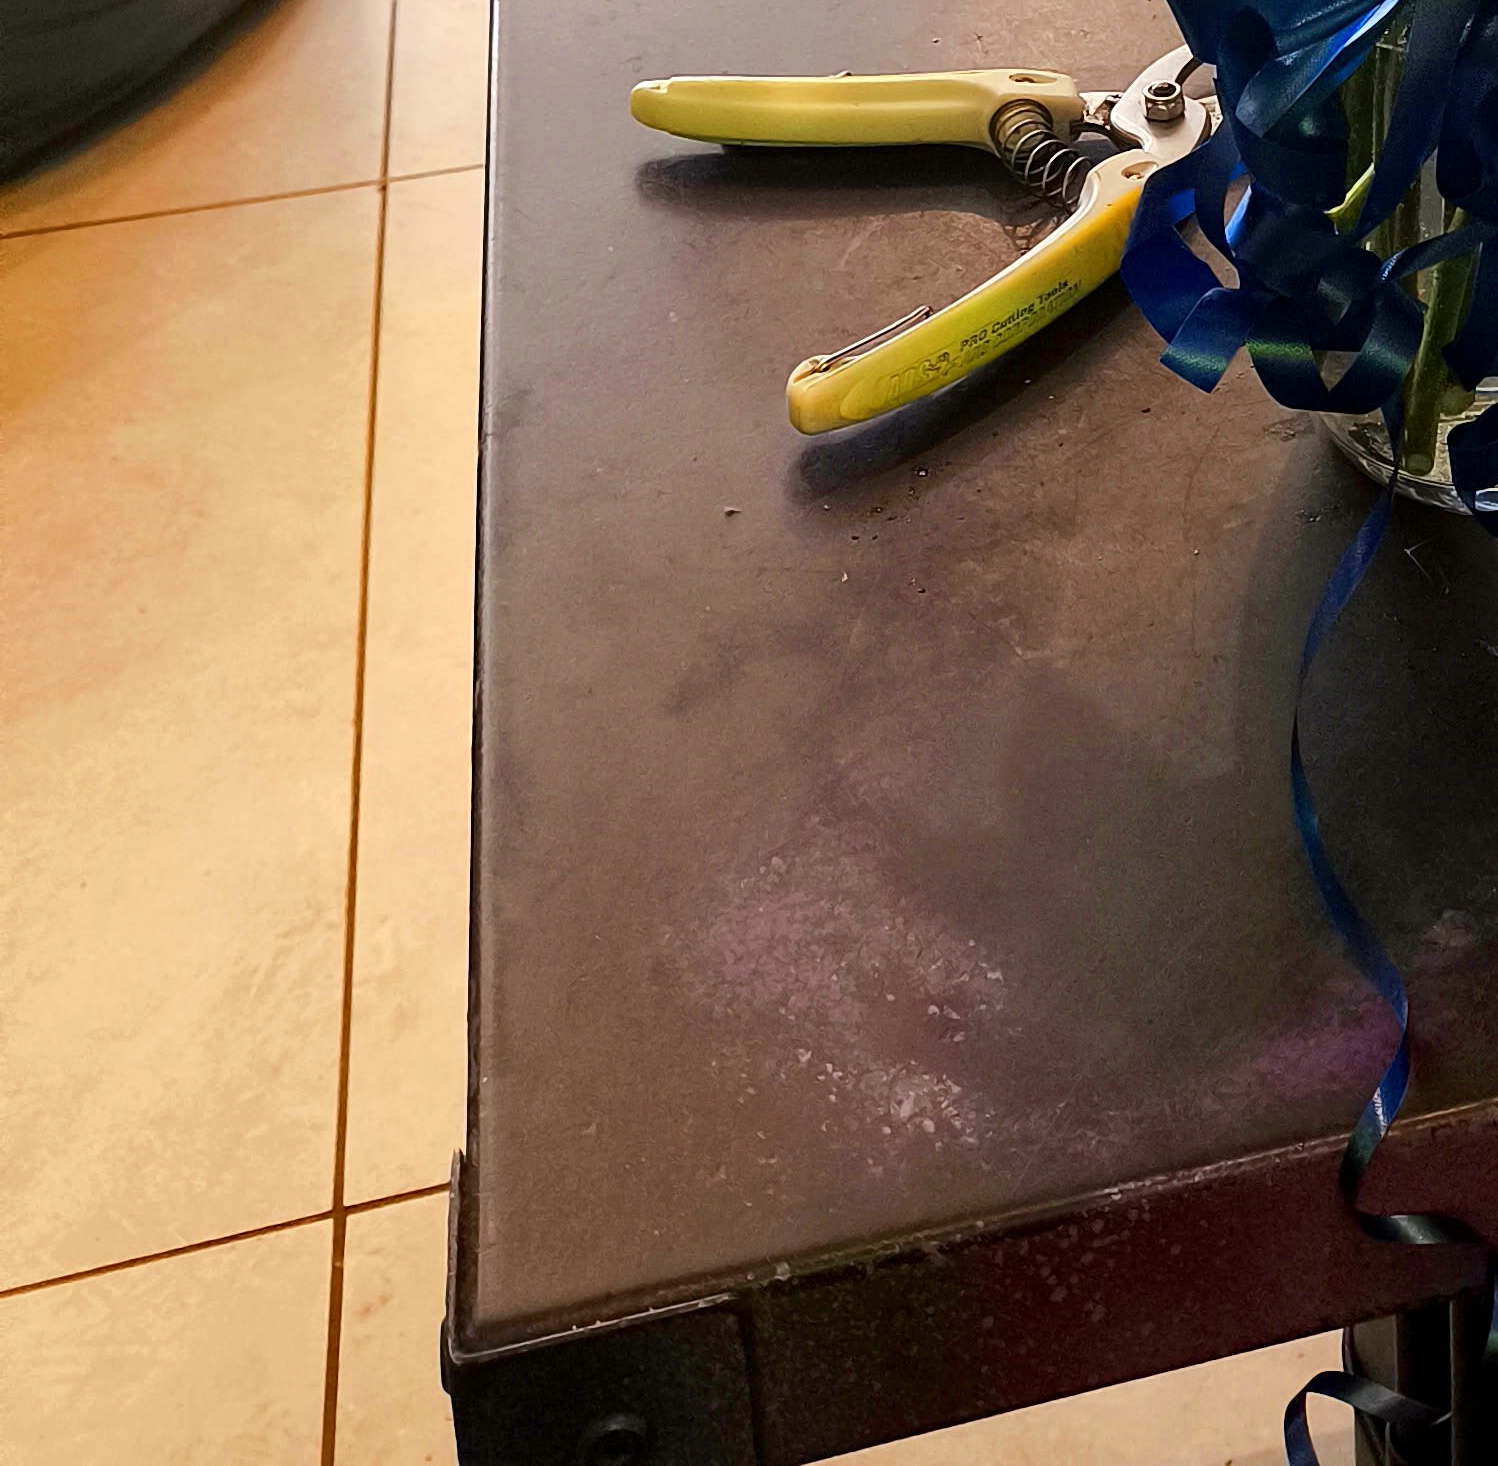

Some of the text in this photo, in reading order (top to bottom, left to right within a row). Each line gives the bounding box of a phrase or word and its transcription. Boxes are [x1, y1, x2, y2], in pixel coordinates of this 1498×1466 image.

[961, 279, 1069, 351] PRO Cutting Tools
